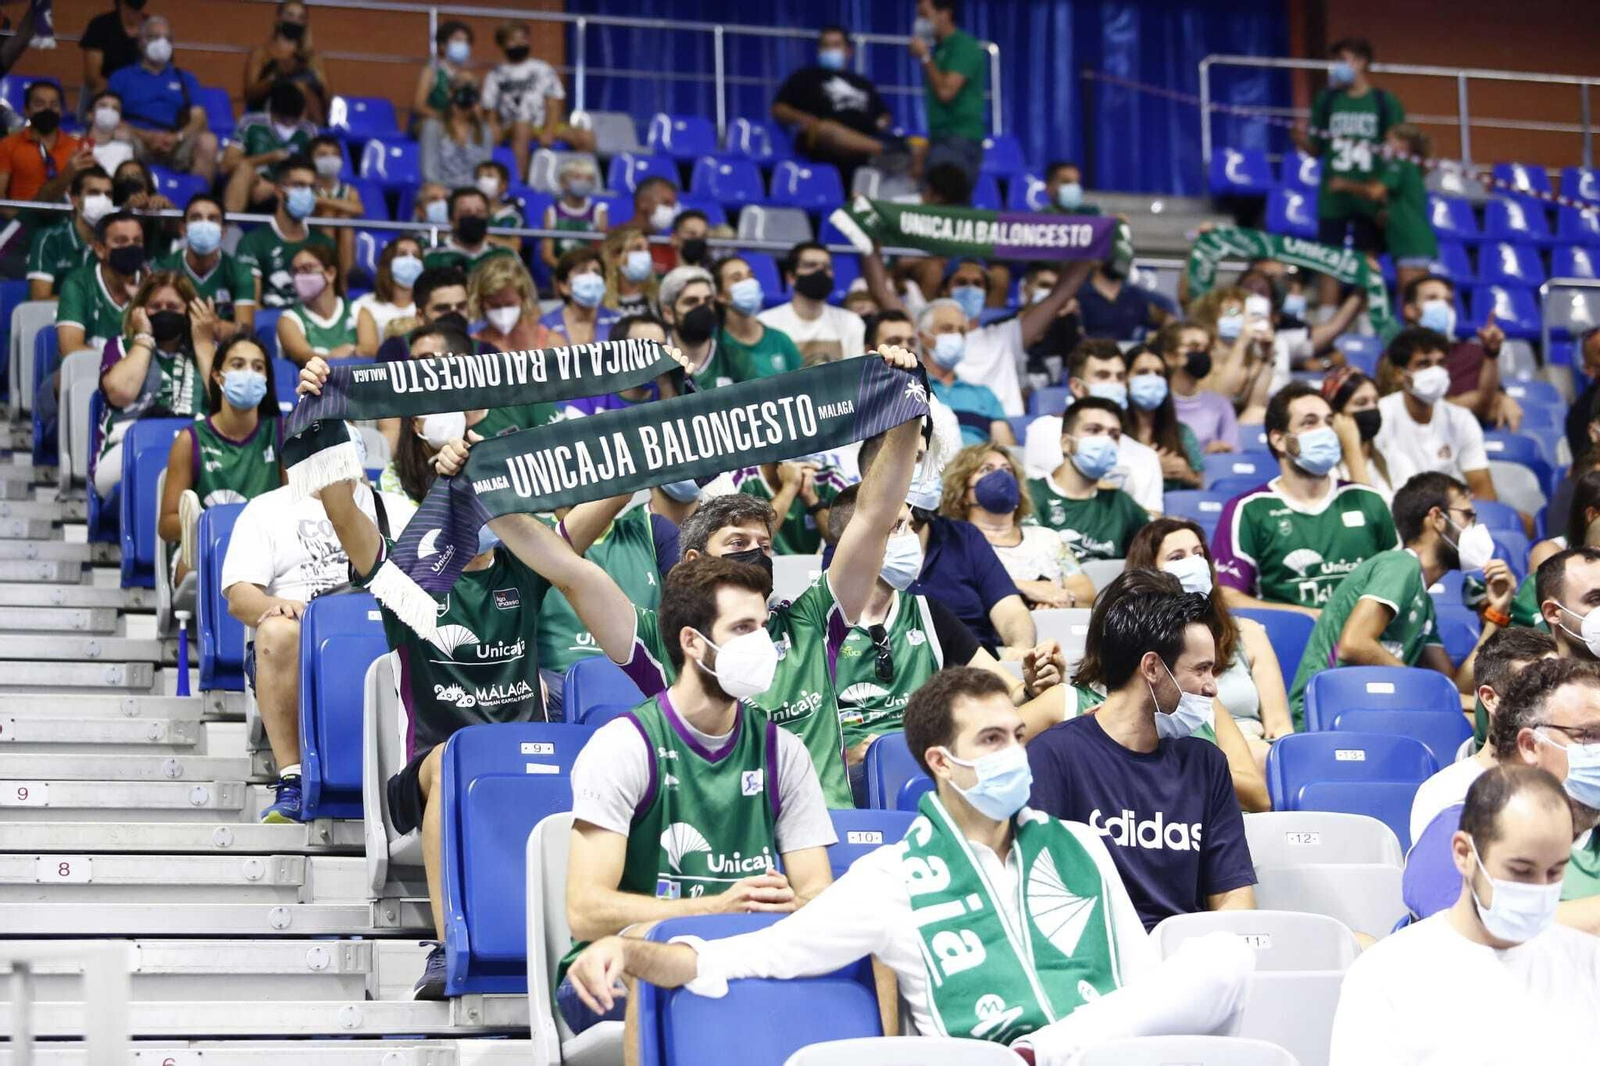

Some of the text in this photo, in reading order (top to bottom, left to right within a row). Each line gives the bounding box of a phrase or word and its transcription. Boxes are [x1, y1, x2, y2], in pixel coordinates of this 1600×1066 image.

[1332, 138, 1372, 172] 34
[387, 349, 548, 394] BALONCESTO
[473, 394, 855, 498] MALAGA UNICAJA BALONCESTO MALAGA
[475, 679, 533, 702] MÁLAGA
[533, 743, 542, 753] 9
[17, 787, 29, 801] 9
[58, 862, 71, 877] 8
